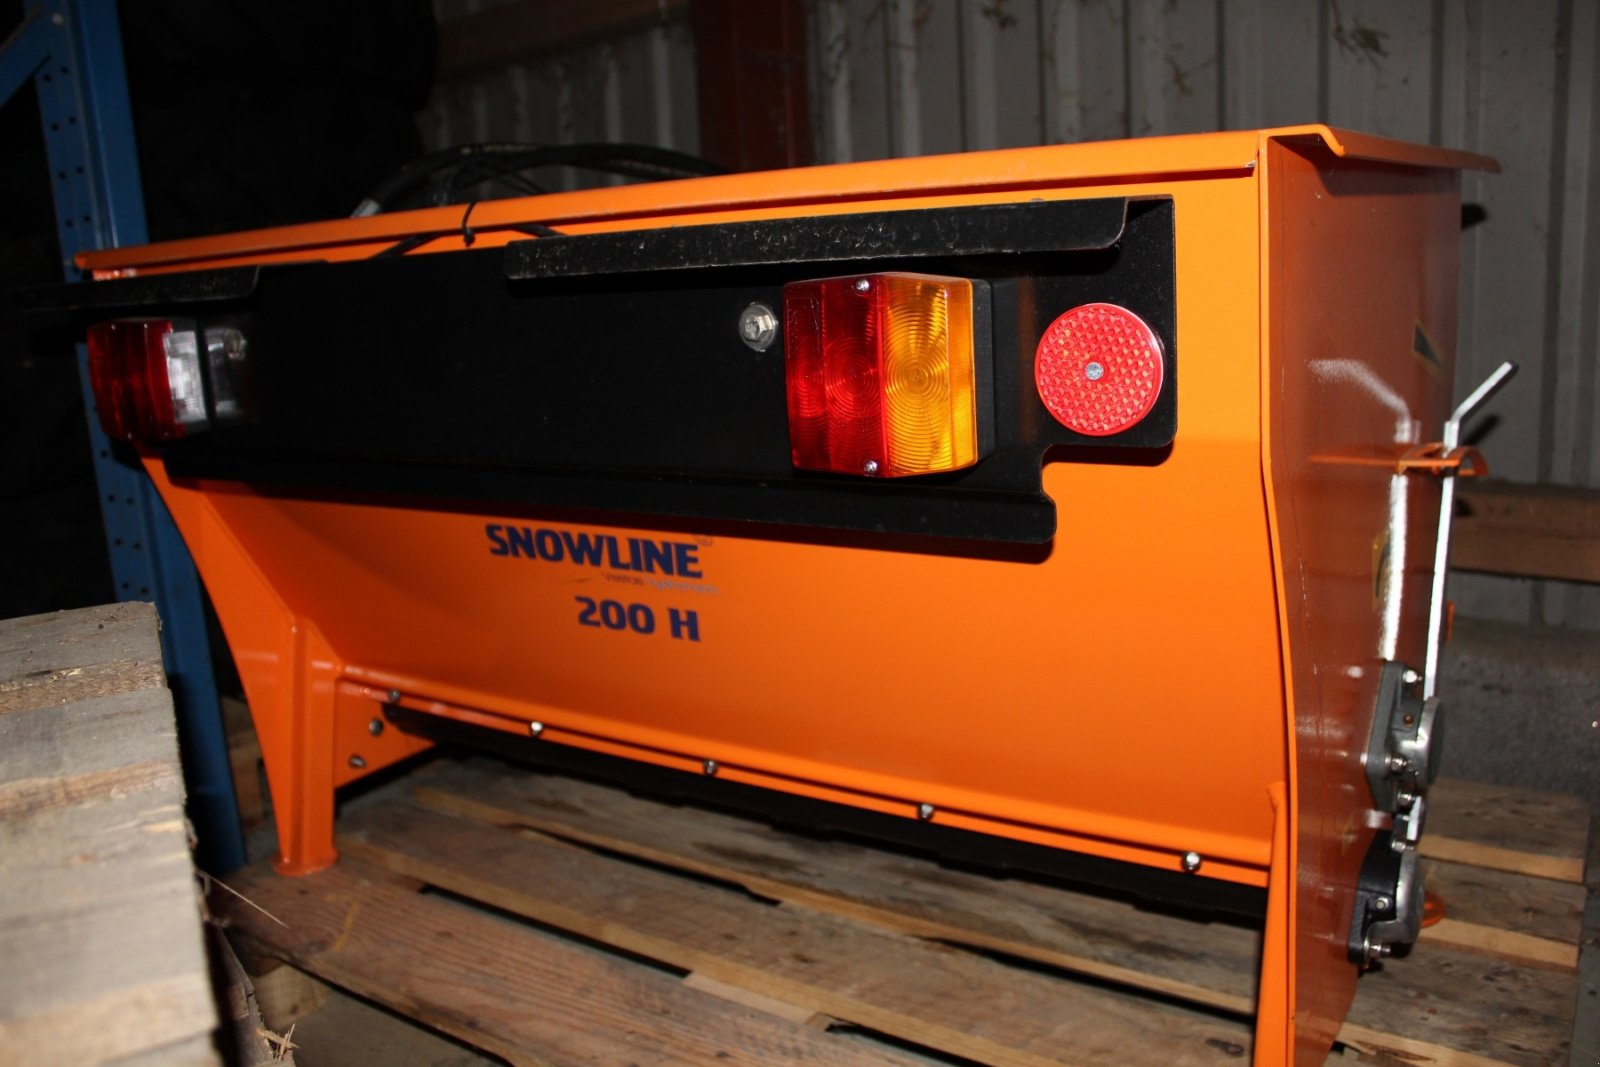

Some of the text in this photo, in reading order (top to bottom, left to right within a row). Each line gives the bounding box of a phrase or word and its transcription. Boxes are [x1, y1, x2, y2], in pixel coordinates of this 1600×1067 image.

[485, 523, 703, 579] SNOWLINE
[575, 596, 701, 642] 200 H
